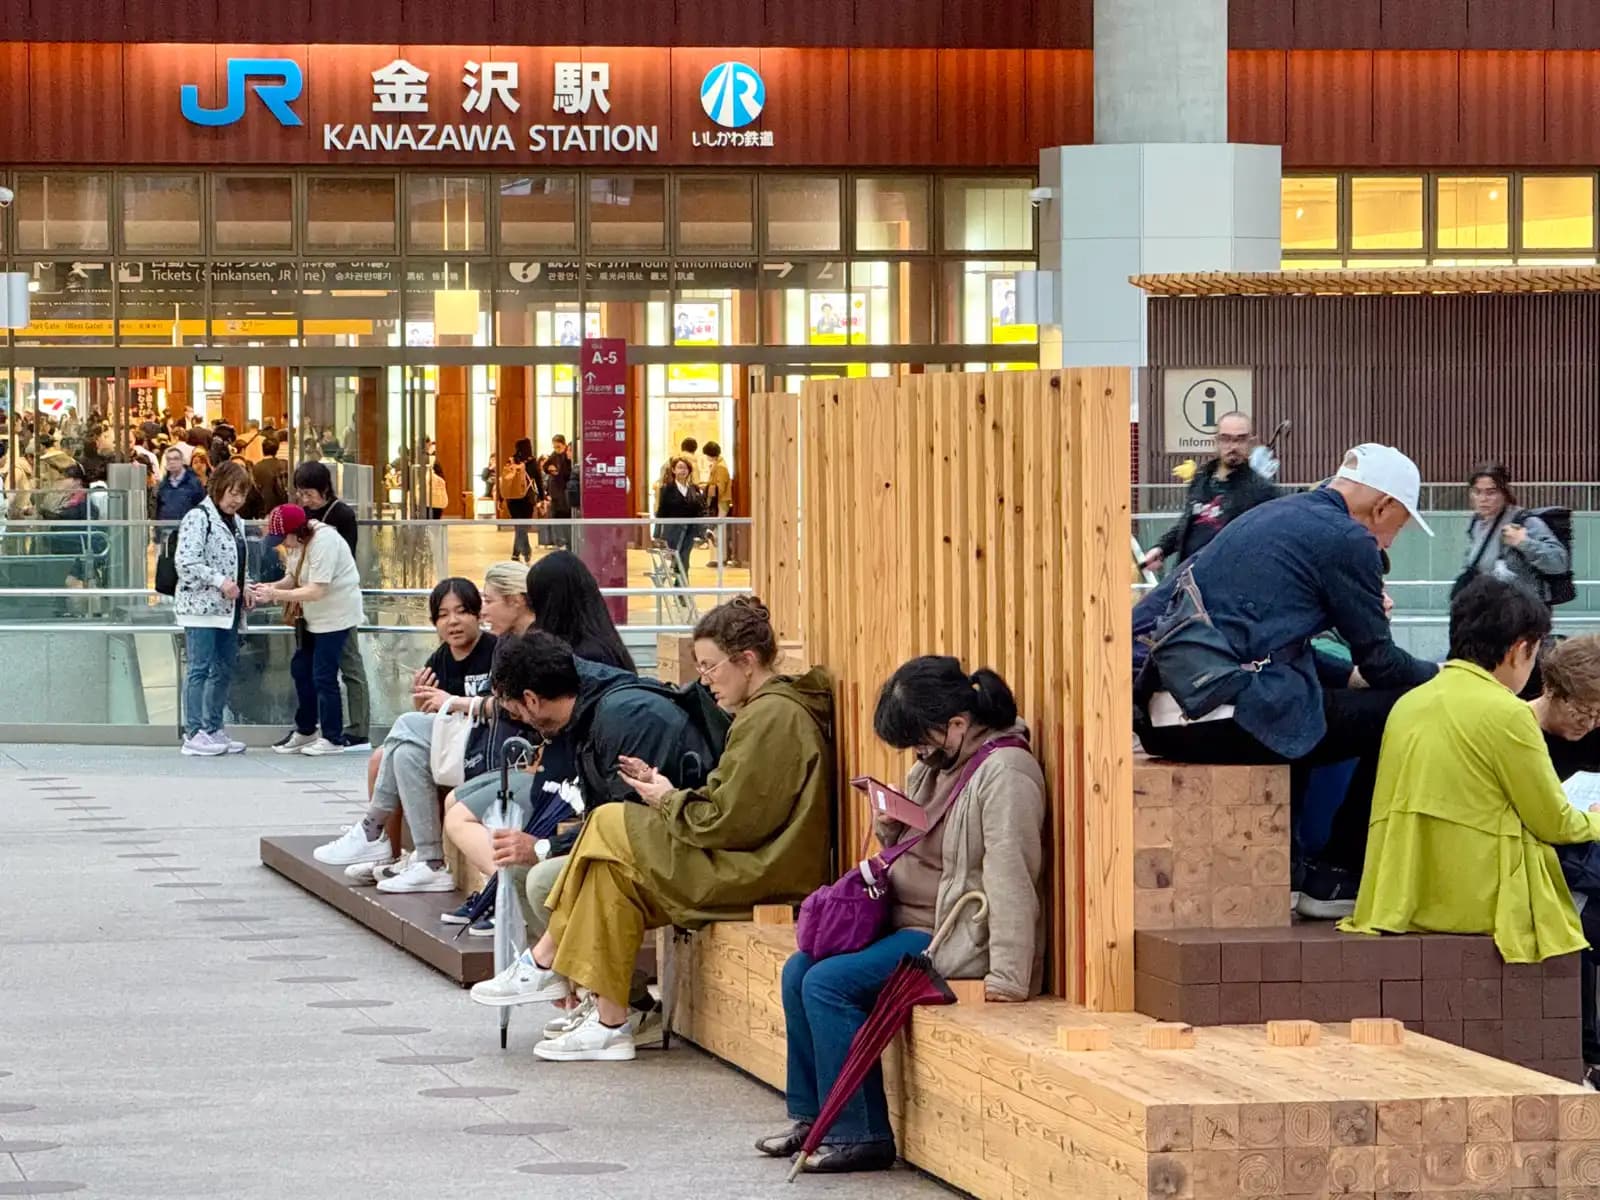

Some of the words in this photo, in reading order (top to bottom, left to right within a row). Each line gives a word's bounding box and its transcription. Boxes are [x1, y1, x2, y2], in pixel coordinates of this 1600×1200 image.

[180, 58, 304, 127] JR
[371, 59, 611, 114] 金沢駅
[324, 124, 514, 151] KANAZAWA
[529, 124, 658, 151] STATION
[692, 131, 774, 147] いしかわ鉄道
[151, 269, 191, 281] Tickets
[278, 269, 291, 281] JR
[591, 351, 618, 364] A-5
[1179, 438, 1216, 447] Inform
